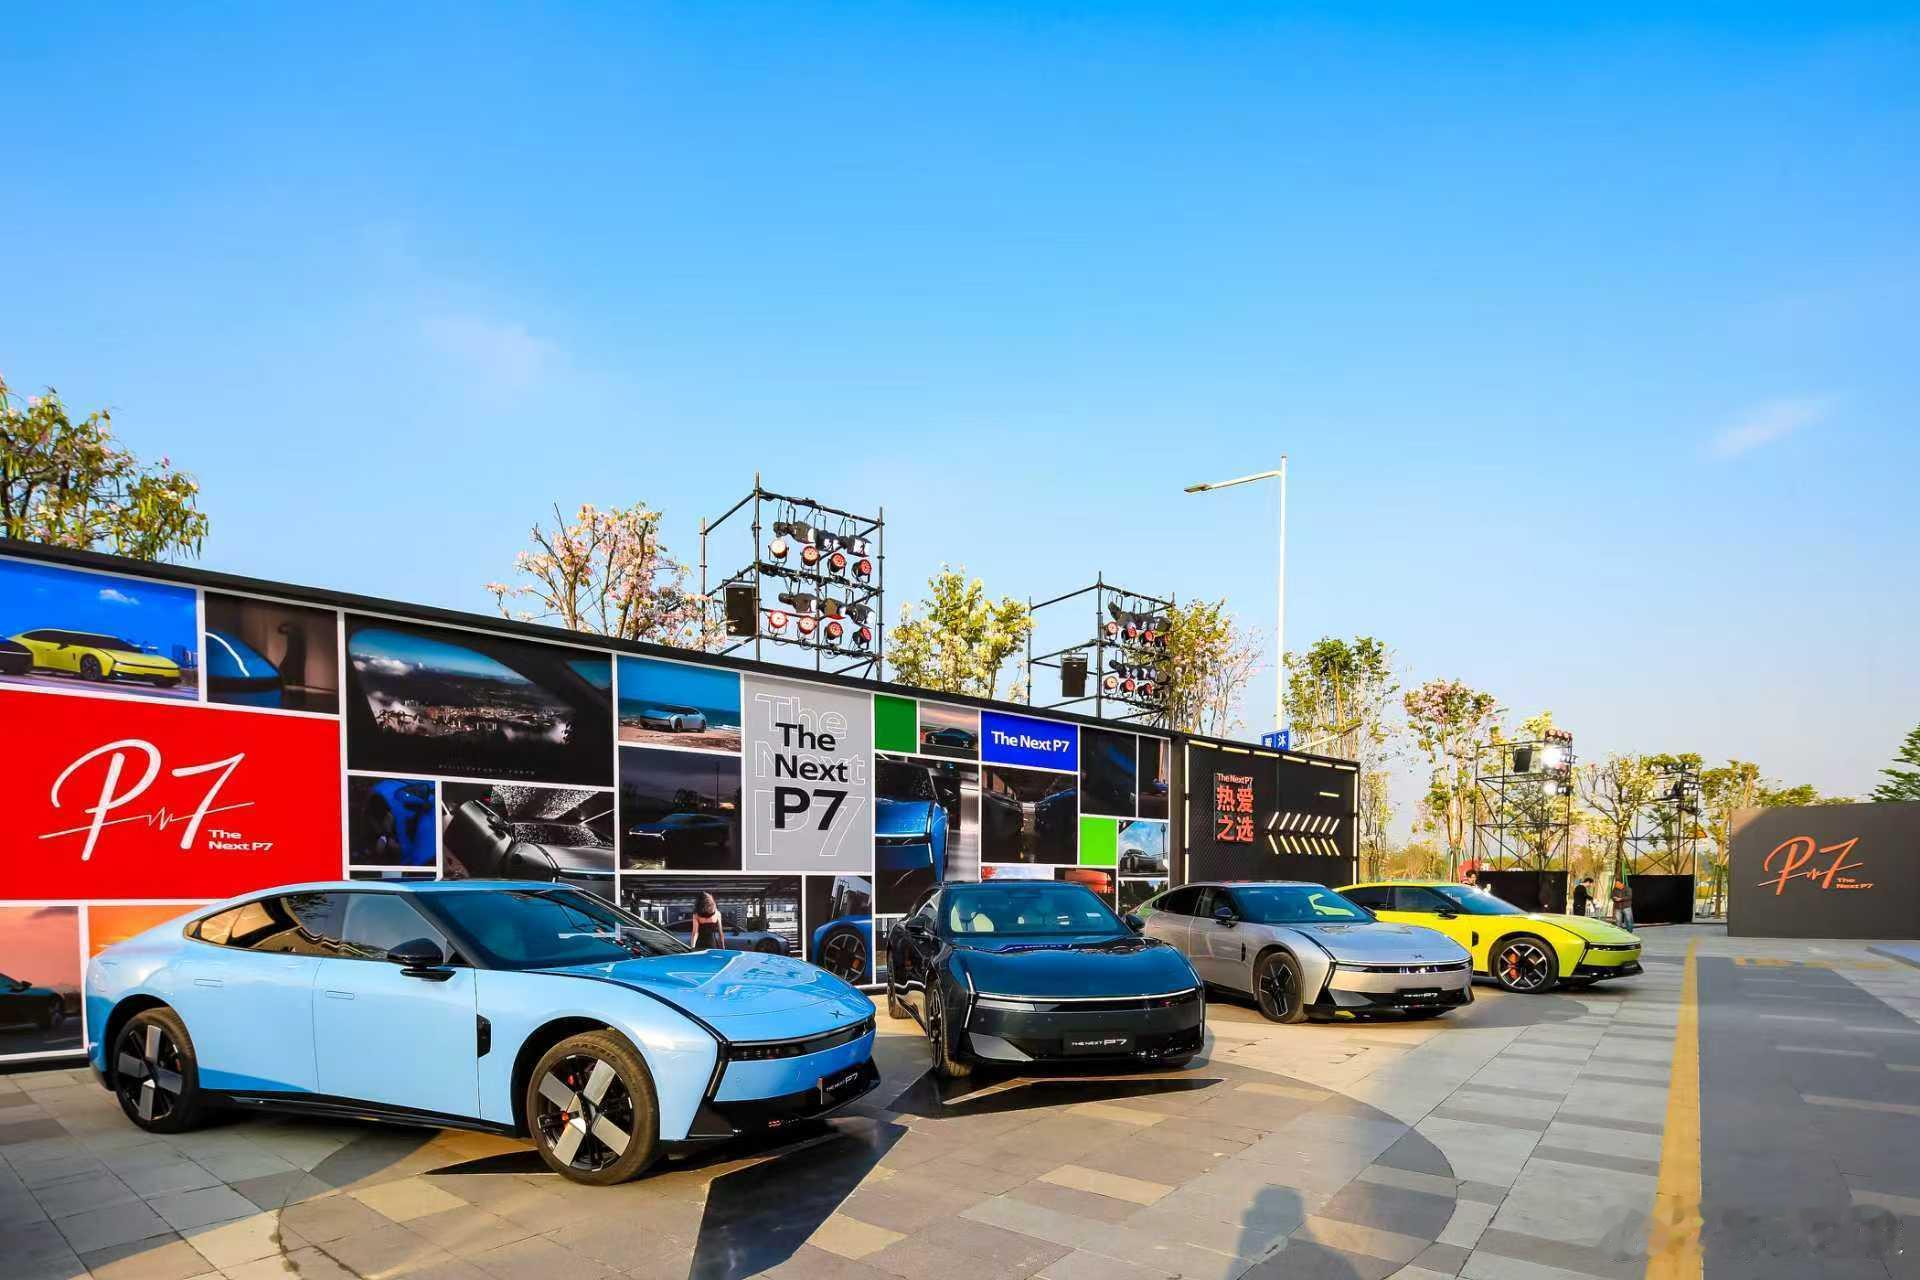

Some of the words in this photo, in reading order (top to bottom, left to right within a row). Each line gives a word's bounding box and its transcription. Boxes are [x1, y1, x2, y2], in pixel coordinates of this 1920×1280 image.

[775, 722, 836, 751] The
[991, 730, 1018, 747] The
[1020, 734, 1052, 751] Next
[1053, 739, 1070, 753] P7
[775, 753, 849, 783] Next
[1217, 773, 1230, 782] The
[1245, 777, 1253, 785] P7
[48, 738, 248, 861] P7
[774, 786, 848, 831] P7
[1216, 784, 1254, 813] 热爱
[208, 829, 242, 839] The
[1216, 814, 1254, 842] 之选
[208, 841, 250, 850] Next
[252, 842, 273, 851] P7
[1761, 835, 1860, 896] P7
[1103, 1038, 1127, 1046] P7
